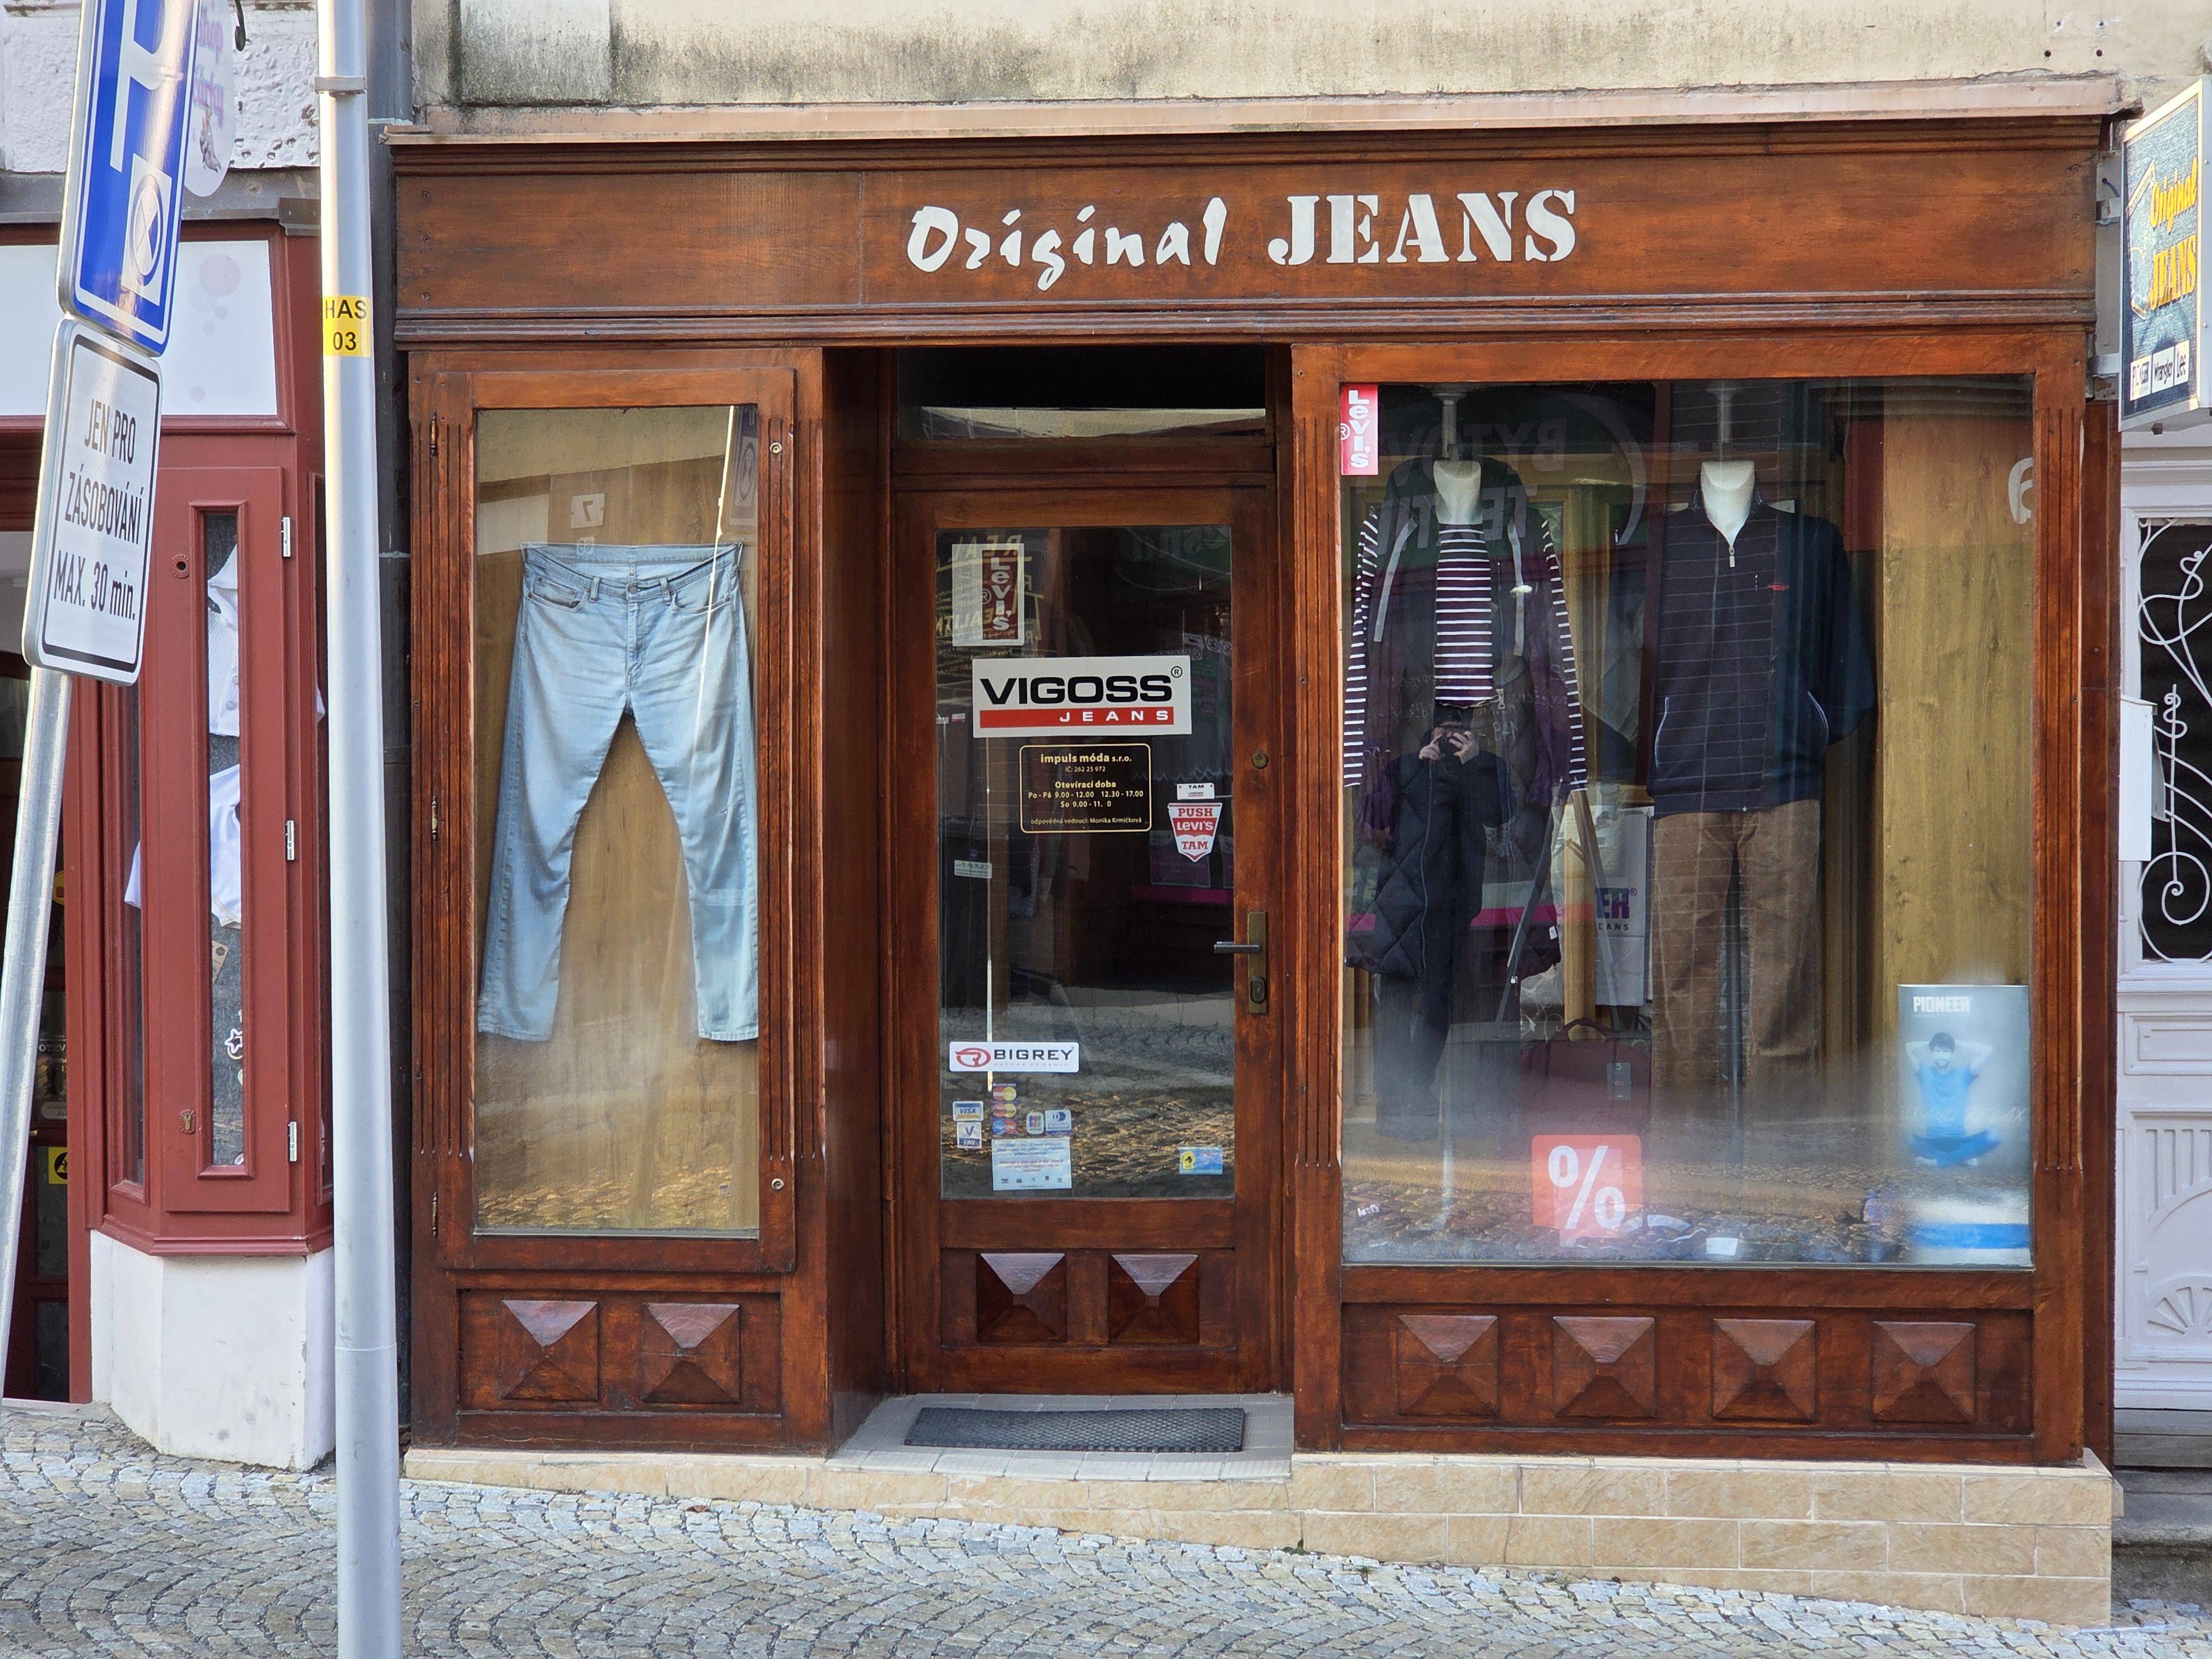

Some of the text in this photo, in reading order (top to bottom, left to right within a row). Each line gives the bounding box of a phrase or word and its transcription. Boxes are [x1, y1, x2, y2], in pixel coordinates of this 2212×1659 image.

[2150, 157, 2197, 233] Original
[906, 189, 1575, 291] Original JEANS
[2149, 233, 2196, 310] JEANS
[325, 299, 367, 320] HAS
[333, 331, 357, 351] 03
[2177, 352, 2186, 378] Lee
[84, 398, 136, 465] JEN PRO
[65, 463, 144, 545] ZÁSOBOVÁNÍ
[54, 550, 136, 620] MAX. 30 min.
[979, 675, 1172, 705] VIGOSS
[1060, 710, 1168, 723] JEANS
[1040, 753, 1077, 765] impuls
[1079, 753, 1109, 763] móda
[1055, 780, 1116, 789] Otevírací doba
[1178, 808, 1213, 817] PUSH
[1181, 841, 1208, 850] TAM
[1913, 996, 1970, 1013] PIONEER
[994, 1049, 1073, 1060] BIGREY
[1548, 1145, 1626, 1229] %
